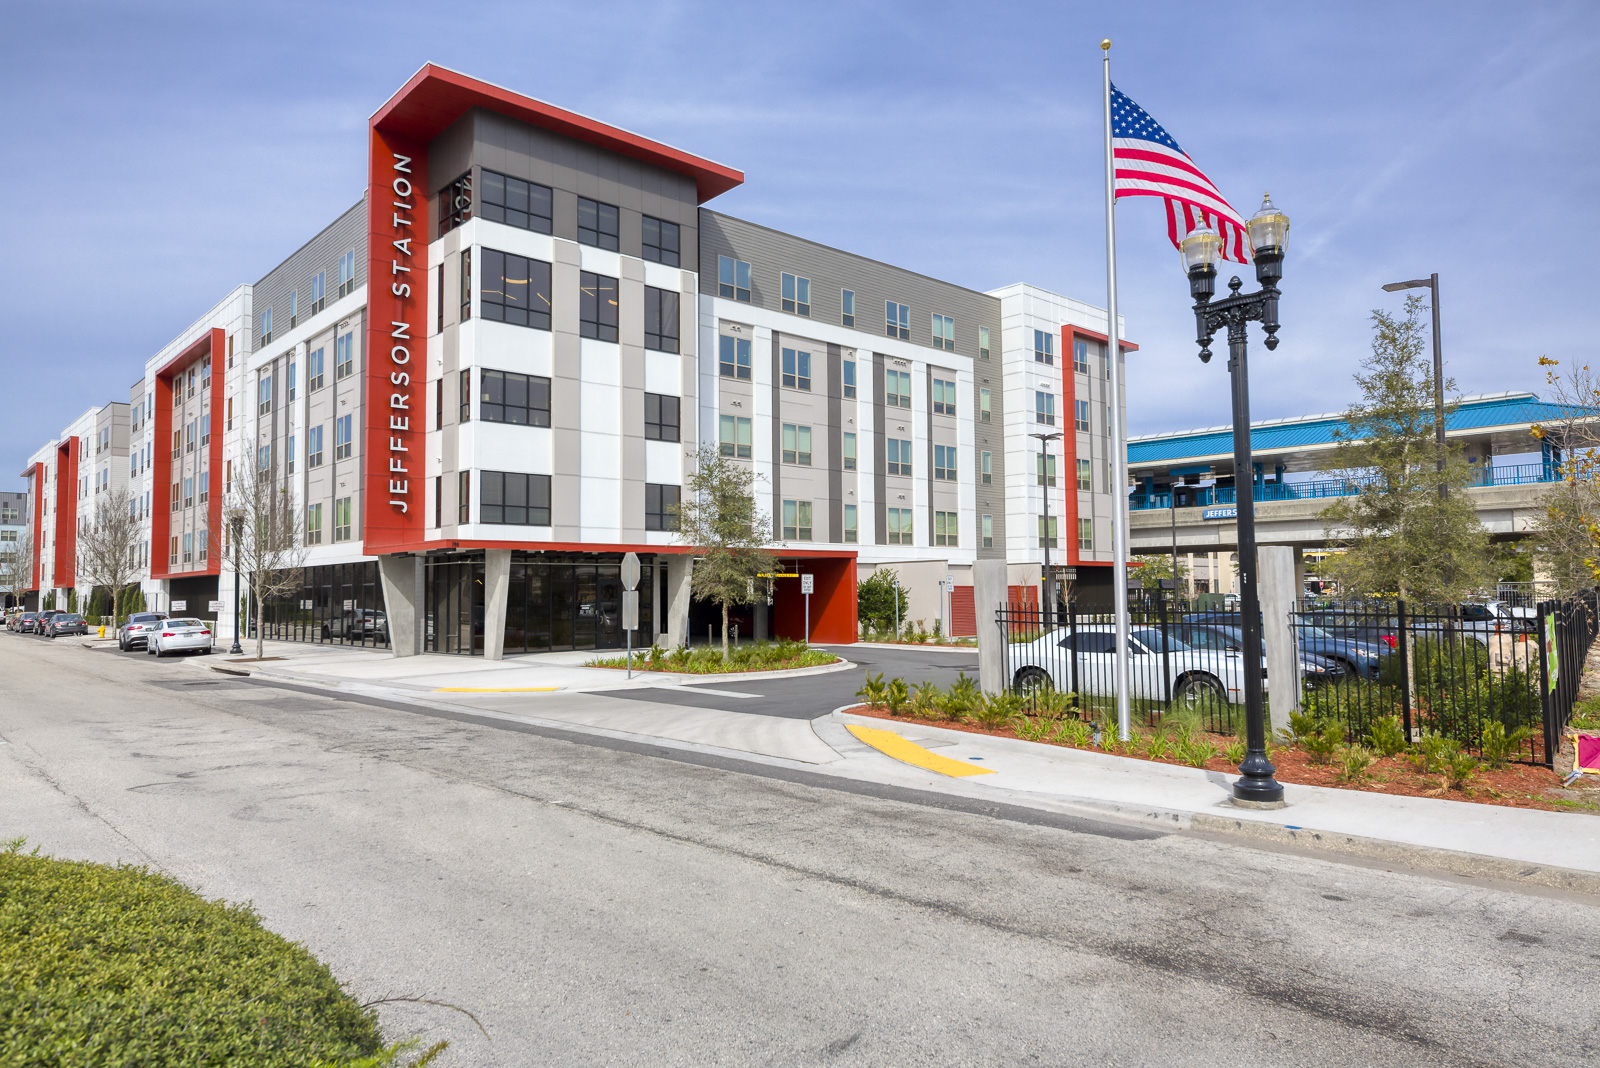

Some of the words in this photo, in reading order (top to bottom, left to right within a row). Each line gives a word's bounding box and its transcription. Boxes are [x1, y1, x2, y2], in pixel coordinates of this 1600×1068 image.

[392, 153, 412, 298] STATION
[389, 320, 410, 514] JEFFERSON
[1206, 508, 1237, 517] JEFFERS
